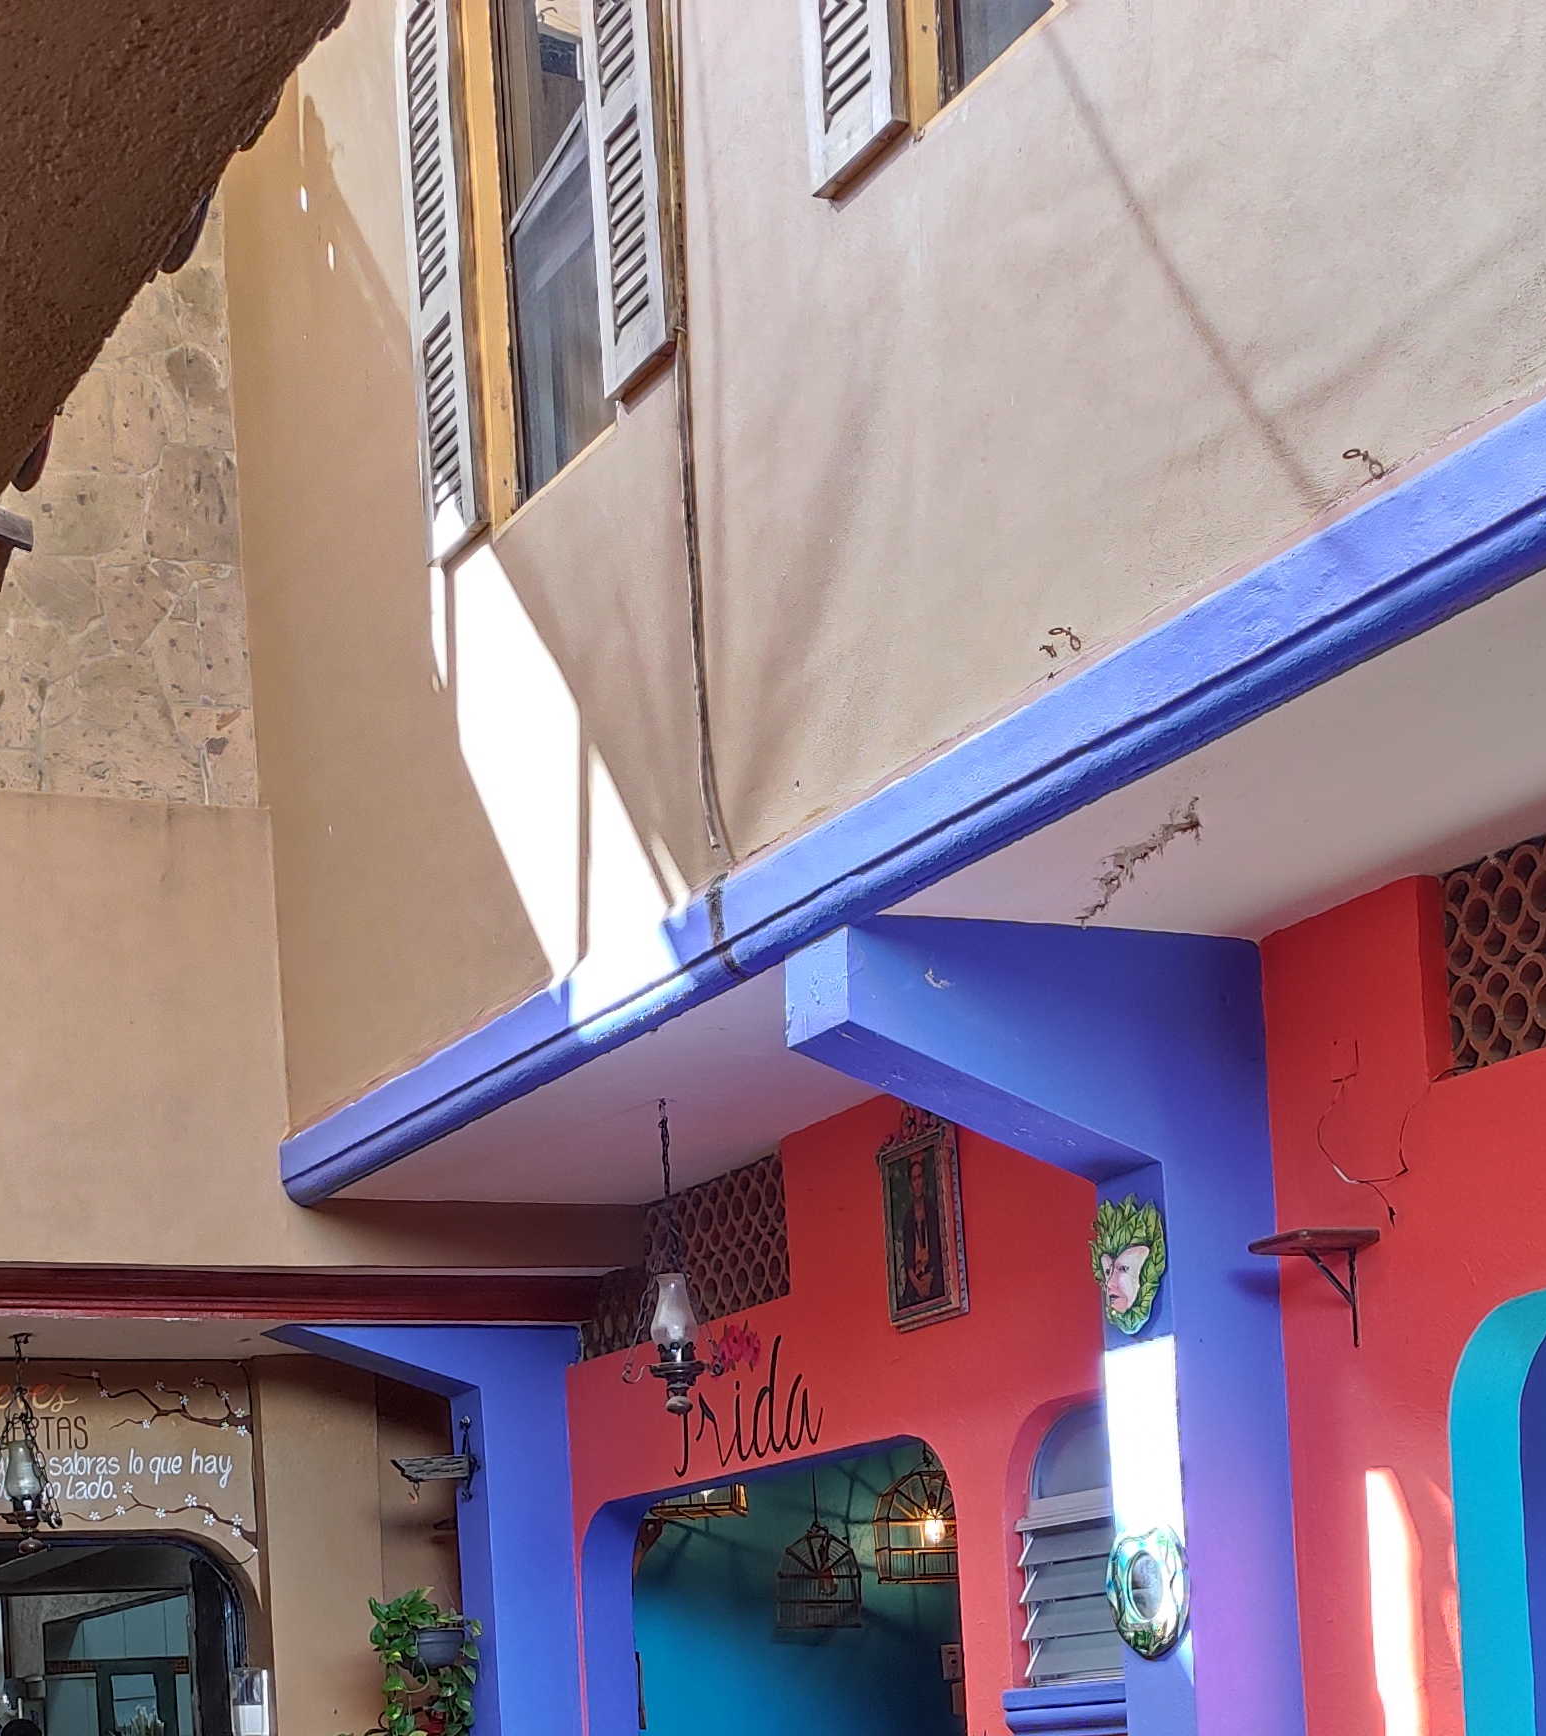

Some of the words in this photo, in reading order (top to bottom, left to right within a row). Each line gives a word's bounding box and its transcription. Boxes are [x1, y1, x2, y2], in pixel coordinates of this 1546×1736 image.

[49, 1450, 120, 1475] sabras
[128, 1448, 143, 1475] lo
[149, 1454, 182, 1484] que
[190, 1449, 232, 1488] hay
[65, 1475, 118, 1500] lado.
